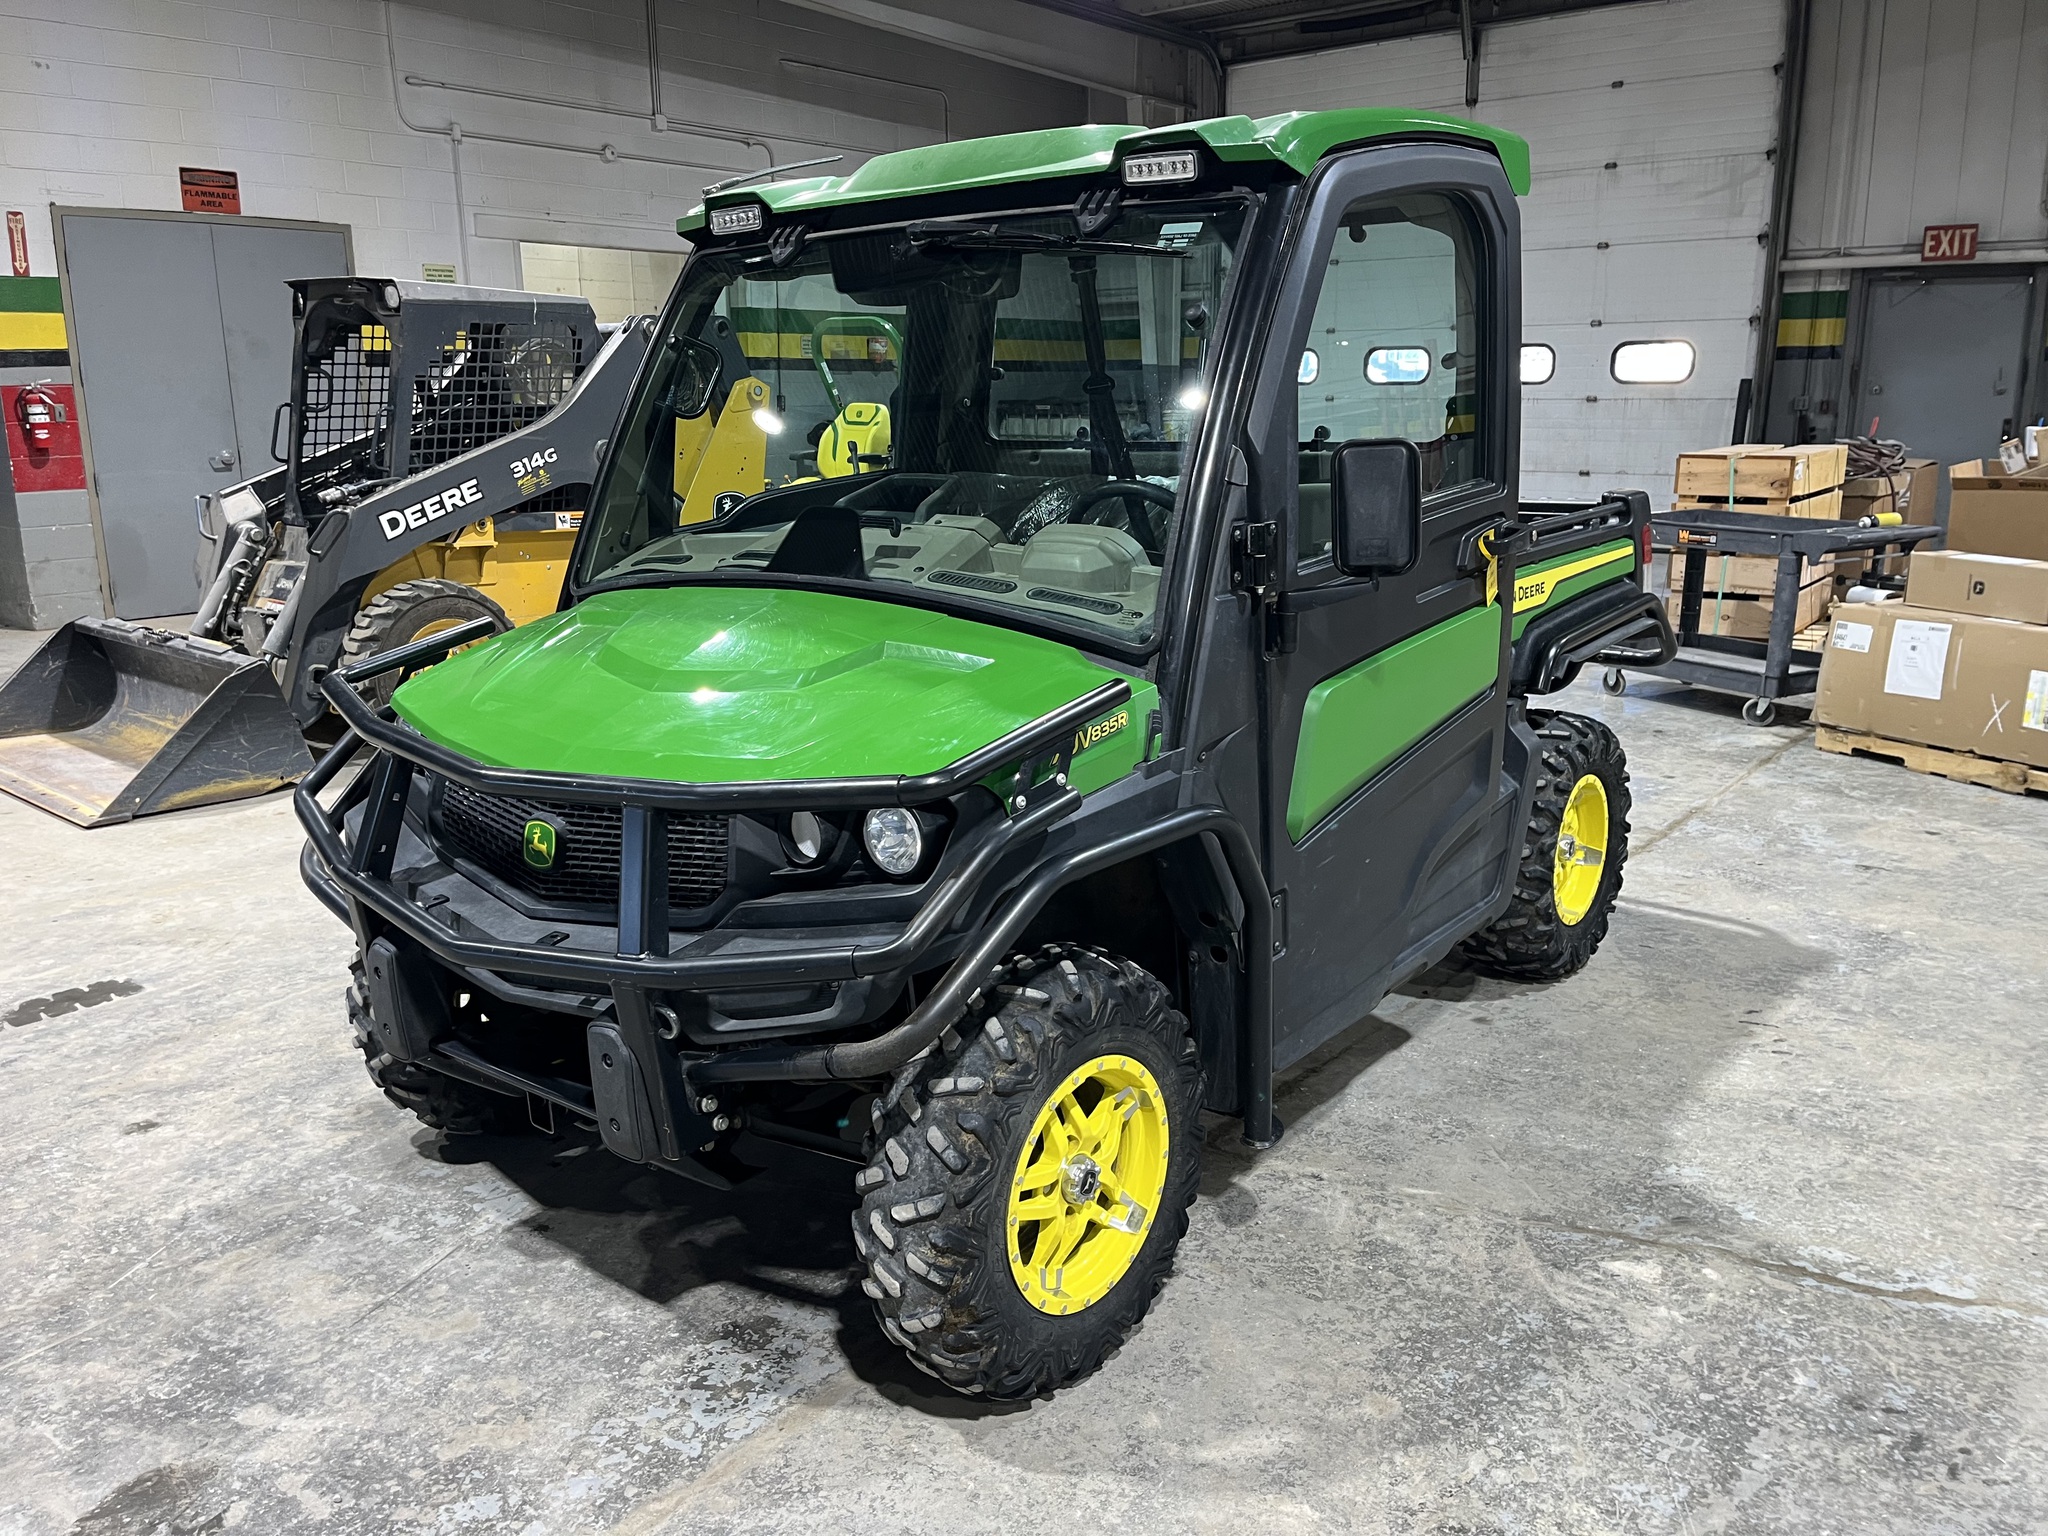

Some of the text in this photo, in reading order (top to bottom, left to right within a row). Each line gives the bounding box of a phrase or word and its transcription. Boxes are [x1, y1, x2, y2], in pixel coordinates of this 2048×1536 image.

[184, 190, 238, 201] FLAMMABLE
[200, 200, 223, 208] AREA
[1924, 228, 1976, 257] EXIT
[509, 447, 558, 478] 314G
[378, 478, 483, 540] DEERE
[1518, 581, 1545, 602] DEERE
